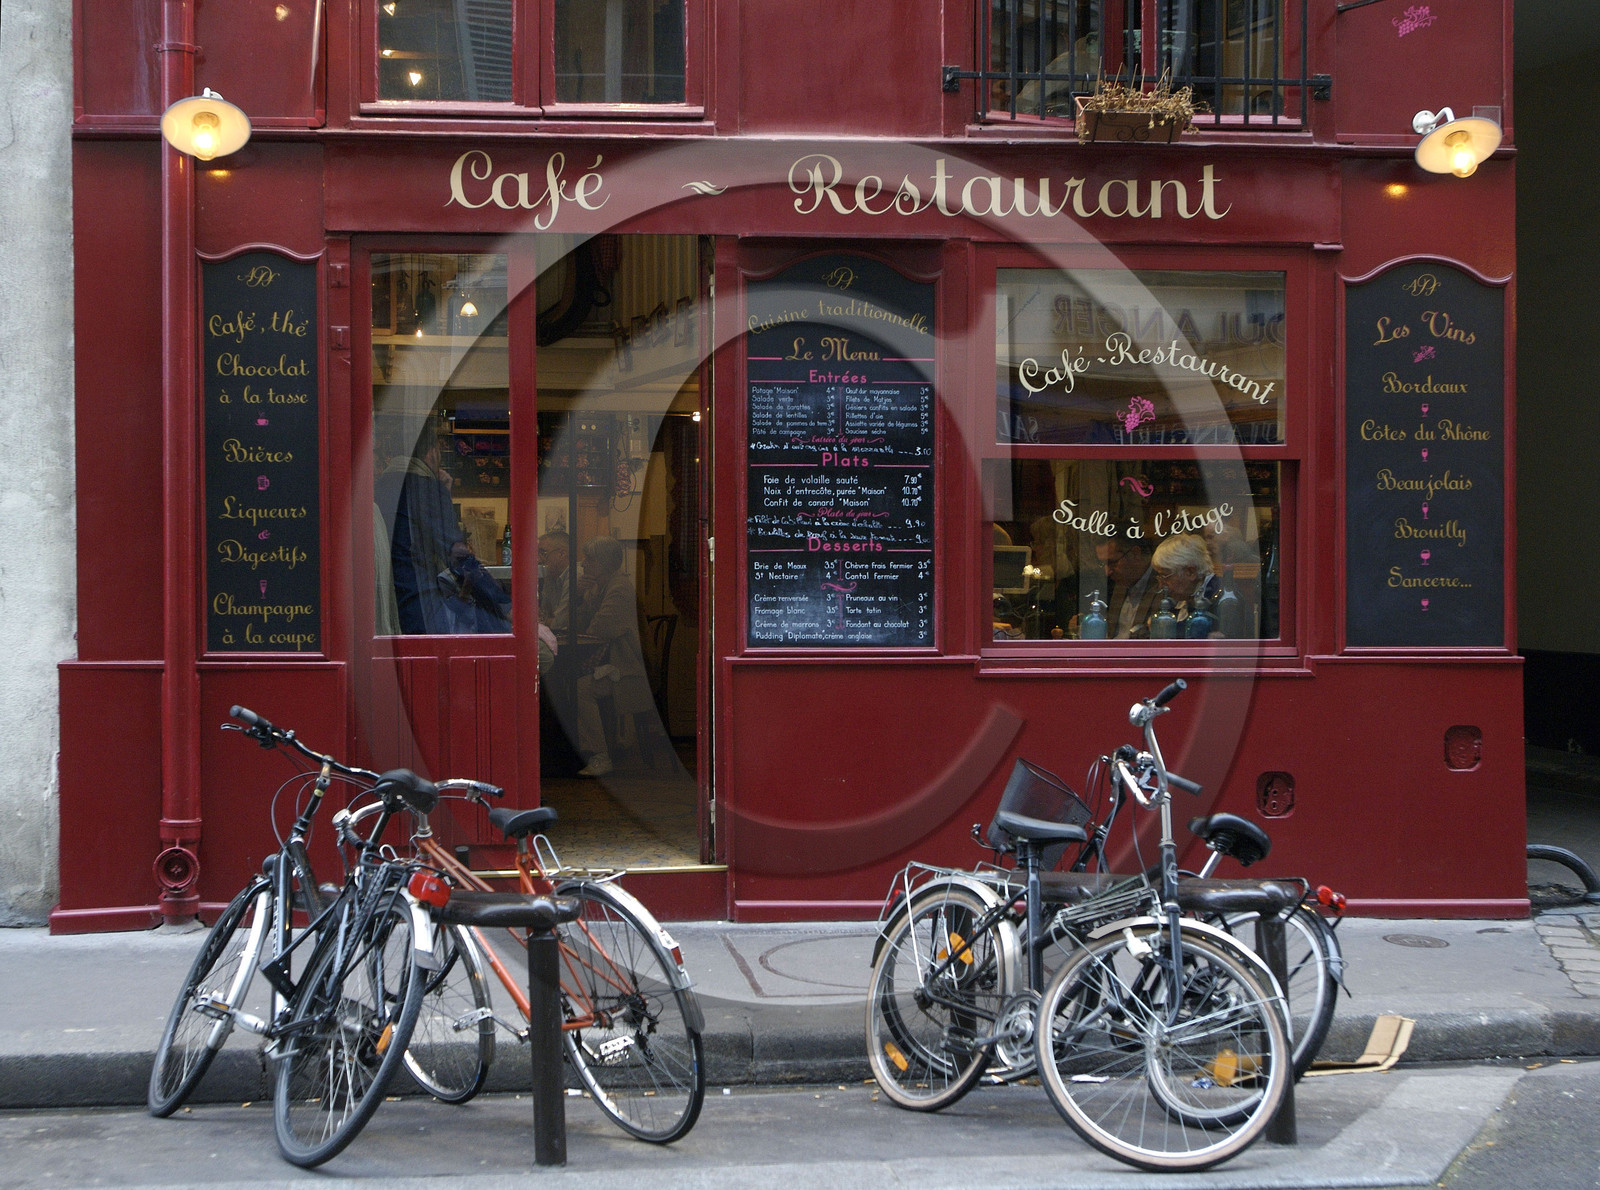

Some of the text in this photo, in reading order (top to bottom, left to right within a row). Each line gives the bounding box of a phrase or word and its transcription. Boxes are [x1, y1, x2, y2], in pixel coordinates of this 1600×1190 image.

[444, 150, 1232, 230] Café Restaurant
[748, 299, 928, 335] Cuisine traditionnelle
[1373, 310, 1476, 346] Les Vins
[785, 337, 880, 361] Le Menu
[216, 352, 310, 376] Chocolat
[1018, 332, 1276, 405] Café Restaurant
[809, 369, 867, 384] Entrées
[1382, 371, 1468, 393] Bordeaux
[219, 385, 309, 404] à la tasse
[1361, 418, 1491, 441] Côtes du Rhône
[838, 435, 848, 443] du
[223, 438, 293, 463] Bières
[822, 453, 869, 467] Plats
[763, 474, 779, 484] Foie
[784, 474, 796, 484] de
[801, 474, 830, 484] volaille
[836, 475, 858, 484] sauté
[1376, 468, 1472, 500] Beaujolais
[764, 486, 781, 495] Noix
[836, 487, 856, 497] purée
[764, 497, 788, 507] Confit
[792, 497, 803, 507] de
[808, 498, 834, 507] canard
[218, 495, 307, 526] Liqueurs
[817, 507, 844, 517] Plats
[846, 509, 855, 517] du
[1052, 499, 1234, 539] Salle à l'étage
[1394, 517, 1466, 547] Brouilly
[808, 537, 883, 552] Desserts
[217, 539, 307, 570] Digestifs
[754, 561, 769, 570] Brie
[773, 562, 783, 570] de
[787, 561, 807, 570] Meaux
[844, 561, 869, 569] Chèvre
[871, 561, 886, 569] frais
[889, 561, 914, 569] fermier
[768, 572, 799, 580] Nectaire
[845, 571, 869, 580] Cantal
[873, 572, 900, 580] fermier
[1387, 566, 1472, 588] Sancerre...
[754, 593, 777, 602] Crème
[778, 594, 809, 602] renversée
[845, 593, 875, 602] Pruneaux
[888, 594, 898, 602] vin
[213, 592, 314, 623] Champagne
[754, 606, 784, 617] Fromage
[786, 606, 806, 614] blanc
[845, 606, 862, 614] Tarte
[866, 606, 882, 614] tatin
[755, 619, 777, 628] Crème
[780, 620, 789, 628] de
[845, 620, 871, 628] Fondant
[883, 620, 910, 628] chocolat
[222, 623, 316, 651] à la coupe
[755, 631, 784, 642] Pudding
[824, 632, 844, 640] crème
[847, 632, 873, 642] anglaise
